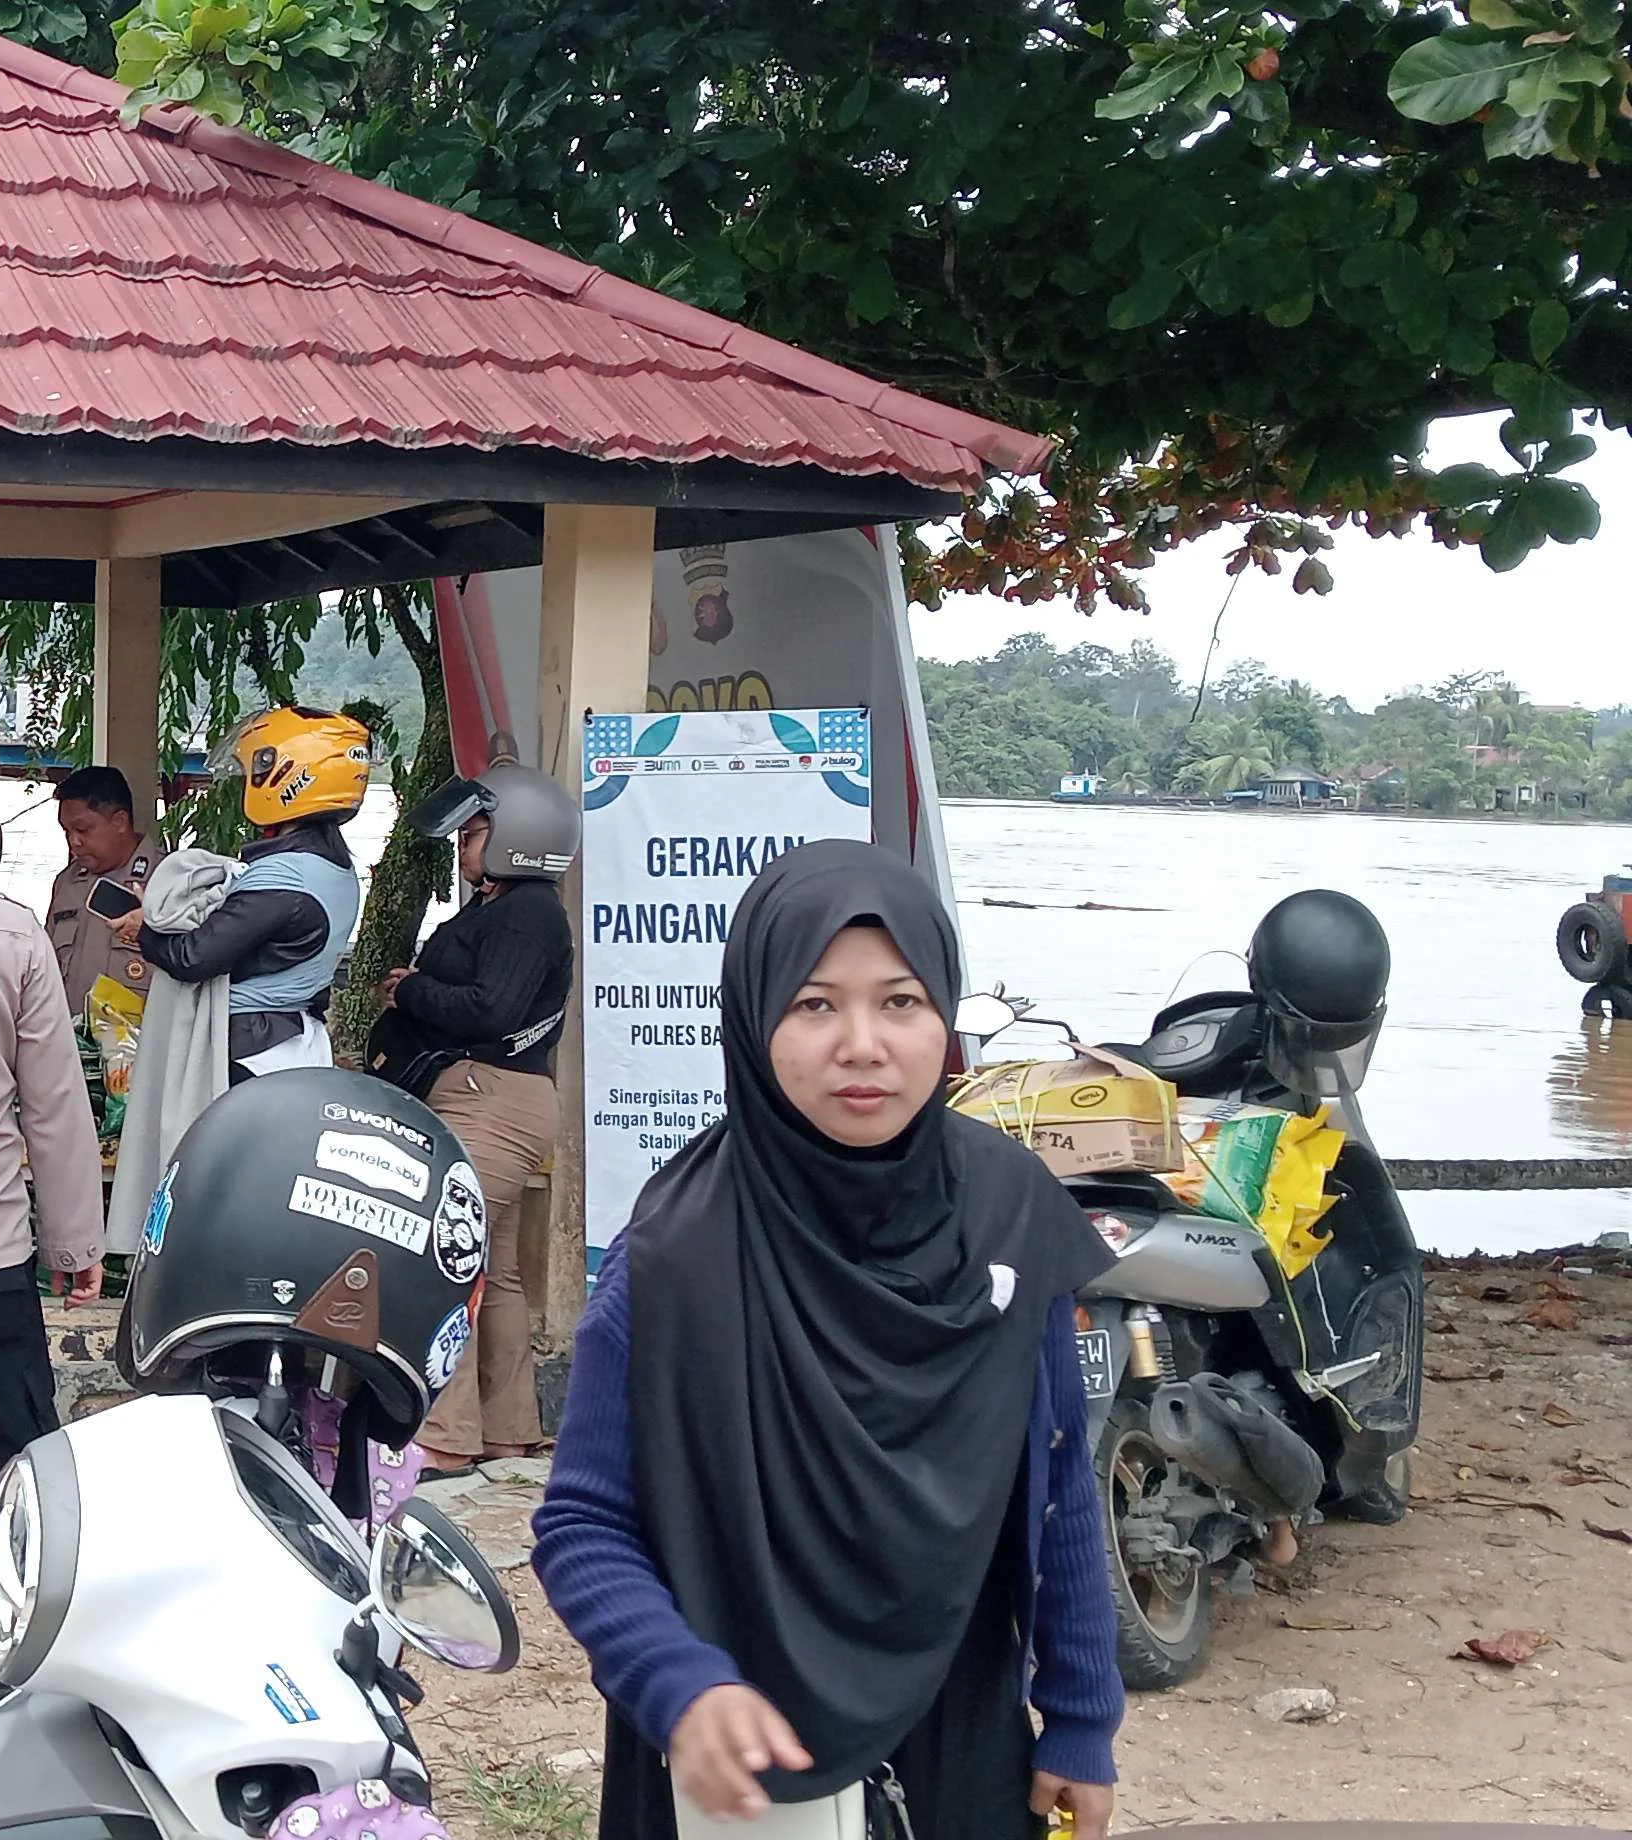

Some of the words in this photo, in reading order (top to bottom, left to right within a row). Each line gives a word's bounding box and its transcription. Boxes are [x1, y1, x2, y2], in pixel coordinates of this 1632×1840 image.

[827, 755, 857, 767] bulog
[279, 767, 311, 808] NHK
[593, 903, 727, 943] PANGAN
[594, 985, 650, 1009] POLRI
[656, 985, 722, 1009] UNTUK
[631, 1024, 696, 1046] POLRES
[609, 1088, 699, 1107] Sinergisitas
[704, 1089, 727, 1106] Pol
[594, 1110, 648, 1129] dengan
[654, 1111, 696, 1130] Bulog
[1184, 1232, 1237, 1247] NMAX
